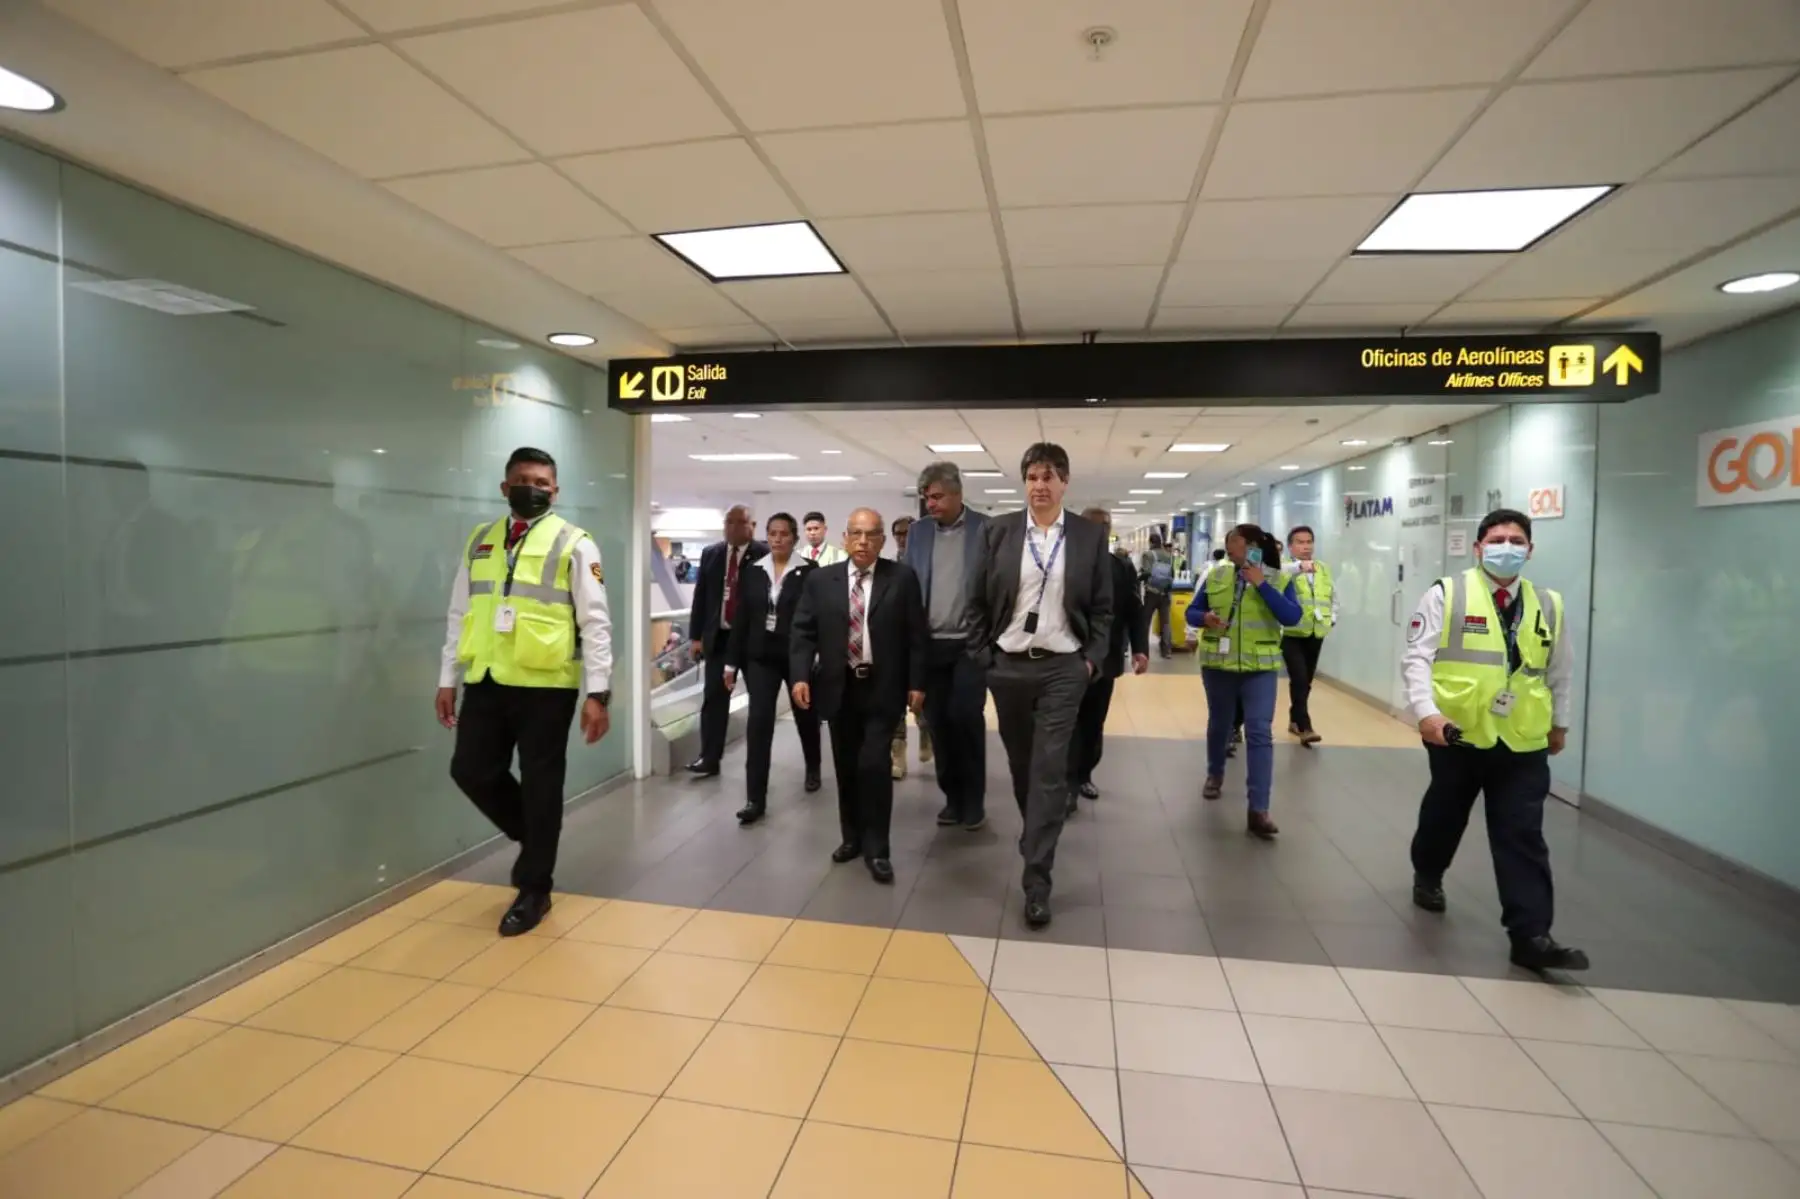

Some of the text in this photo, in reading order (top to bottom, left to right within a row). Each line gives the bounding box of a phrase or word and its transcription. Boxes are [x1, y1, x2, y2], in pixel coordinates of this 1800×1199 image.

[1361, 346, 1545, 367] Oficinas de Aerolíneas
[687, 364, 727, 380] Salida
[1445, 371, 1544, 388] Airlines Offices
[687, 386, 707, 400] Exit
[1353, 496, 1393, 518] LATAM
[1530, 487, 1560, 514] GOL
